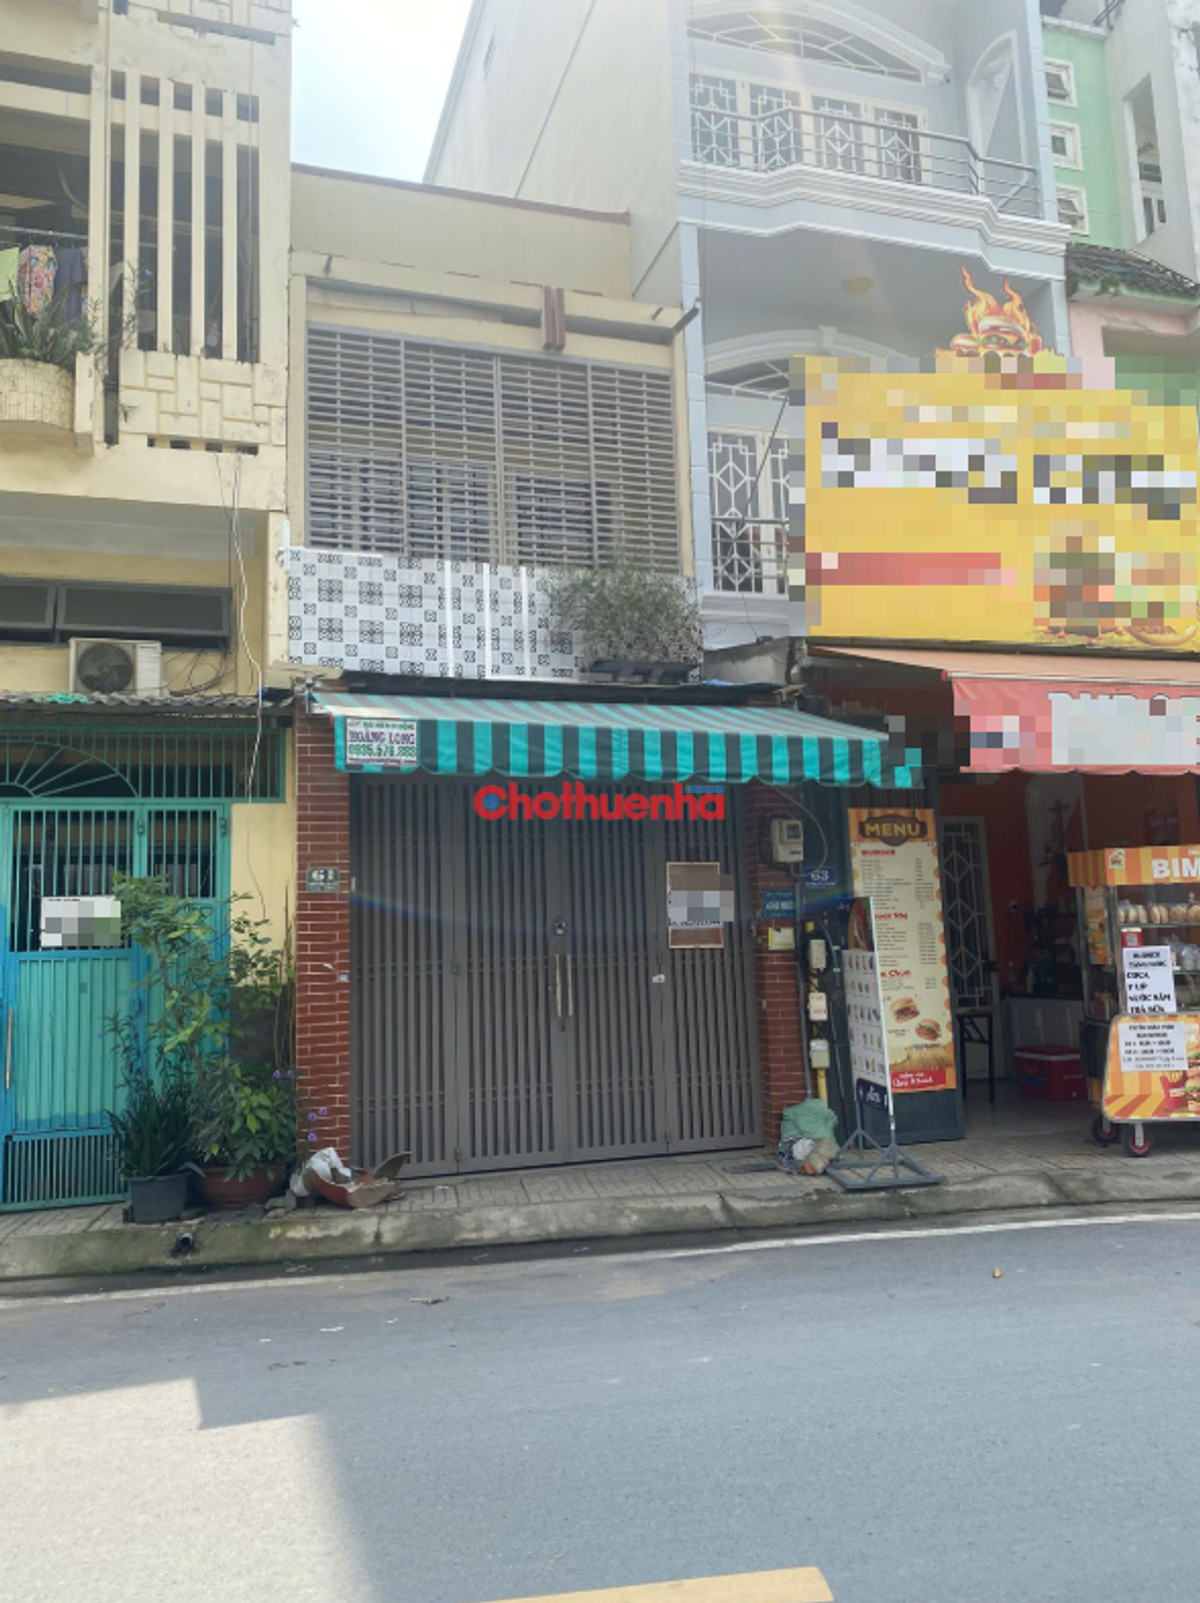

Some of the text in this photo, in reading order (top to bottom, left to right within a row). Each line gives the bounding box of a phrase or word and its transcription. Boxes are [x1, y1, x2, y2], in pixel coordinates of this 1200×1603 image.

[388, 732, 415, 745] LONG
[864, 823, 920, 837] MENU
[810, 869, 829, 881] 63
